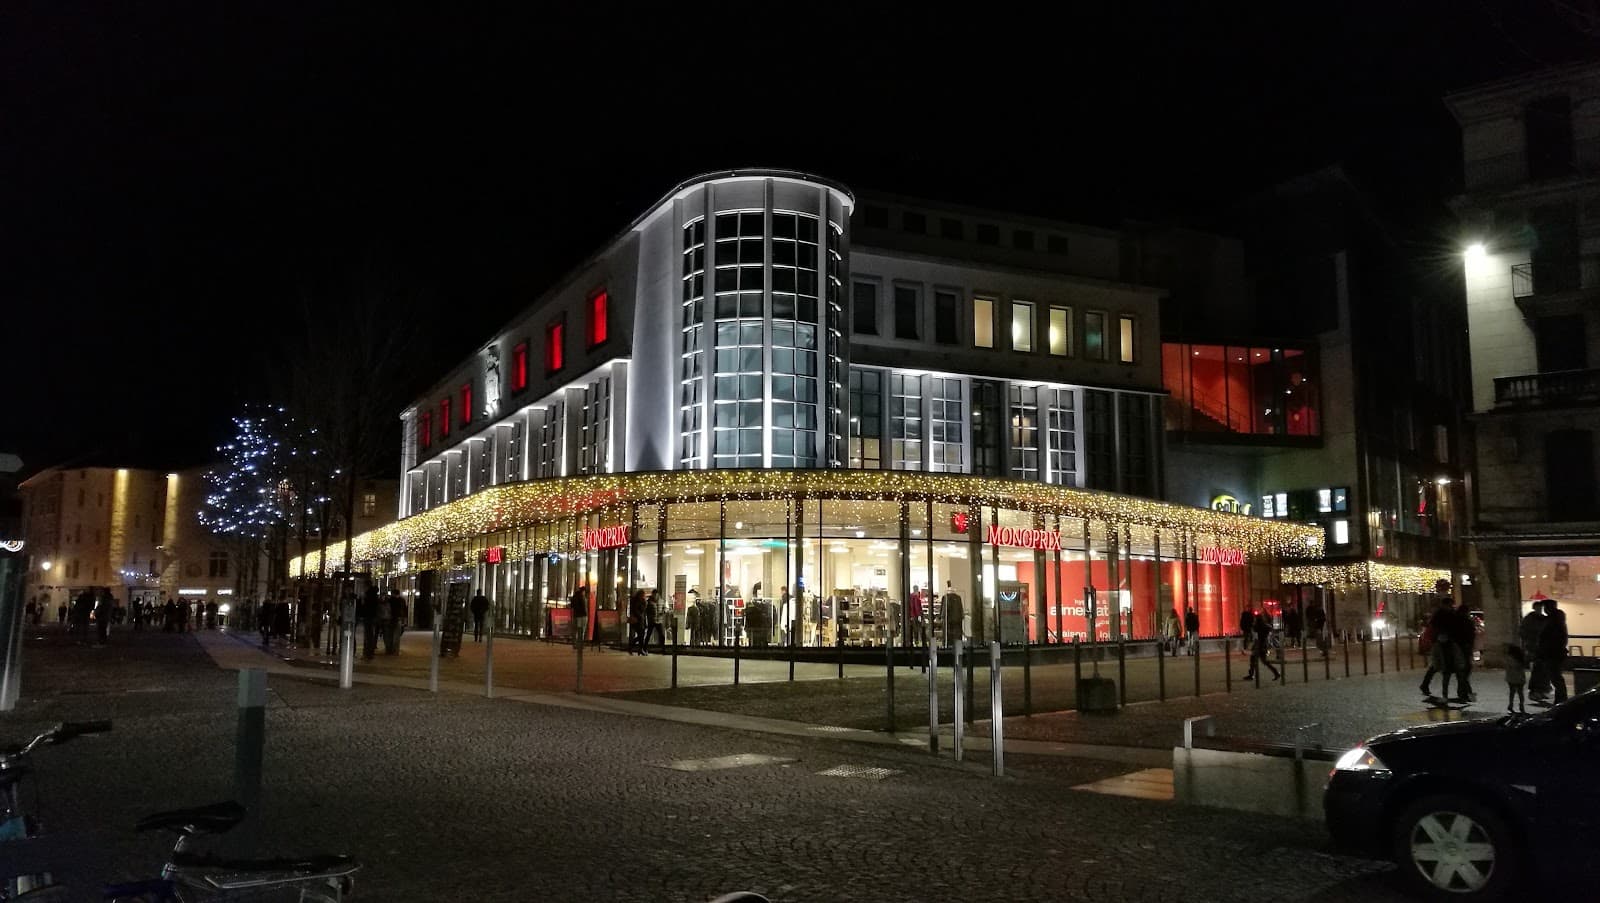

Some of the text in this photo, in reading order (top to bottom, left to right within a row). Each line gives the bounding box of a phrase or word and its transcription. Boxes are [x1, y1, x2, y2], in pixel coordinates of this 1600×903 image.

[583, 525, 628, 550] MONOPRIX
[988, 525, 1061, 551] MONOPRIX
[1202, 546, 1245, 566] MONOPRIX
